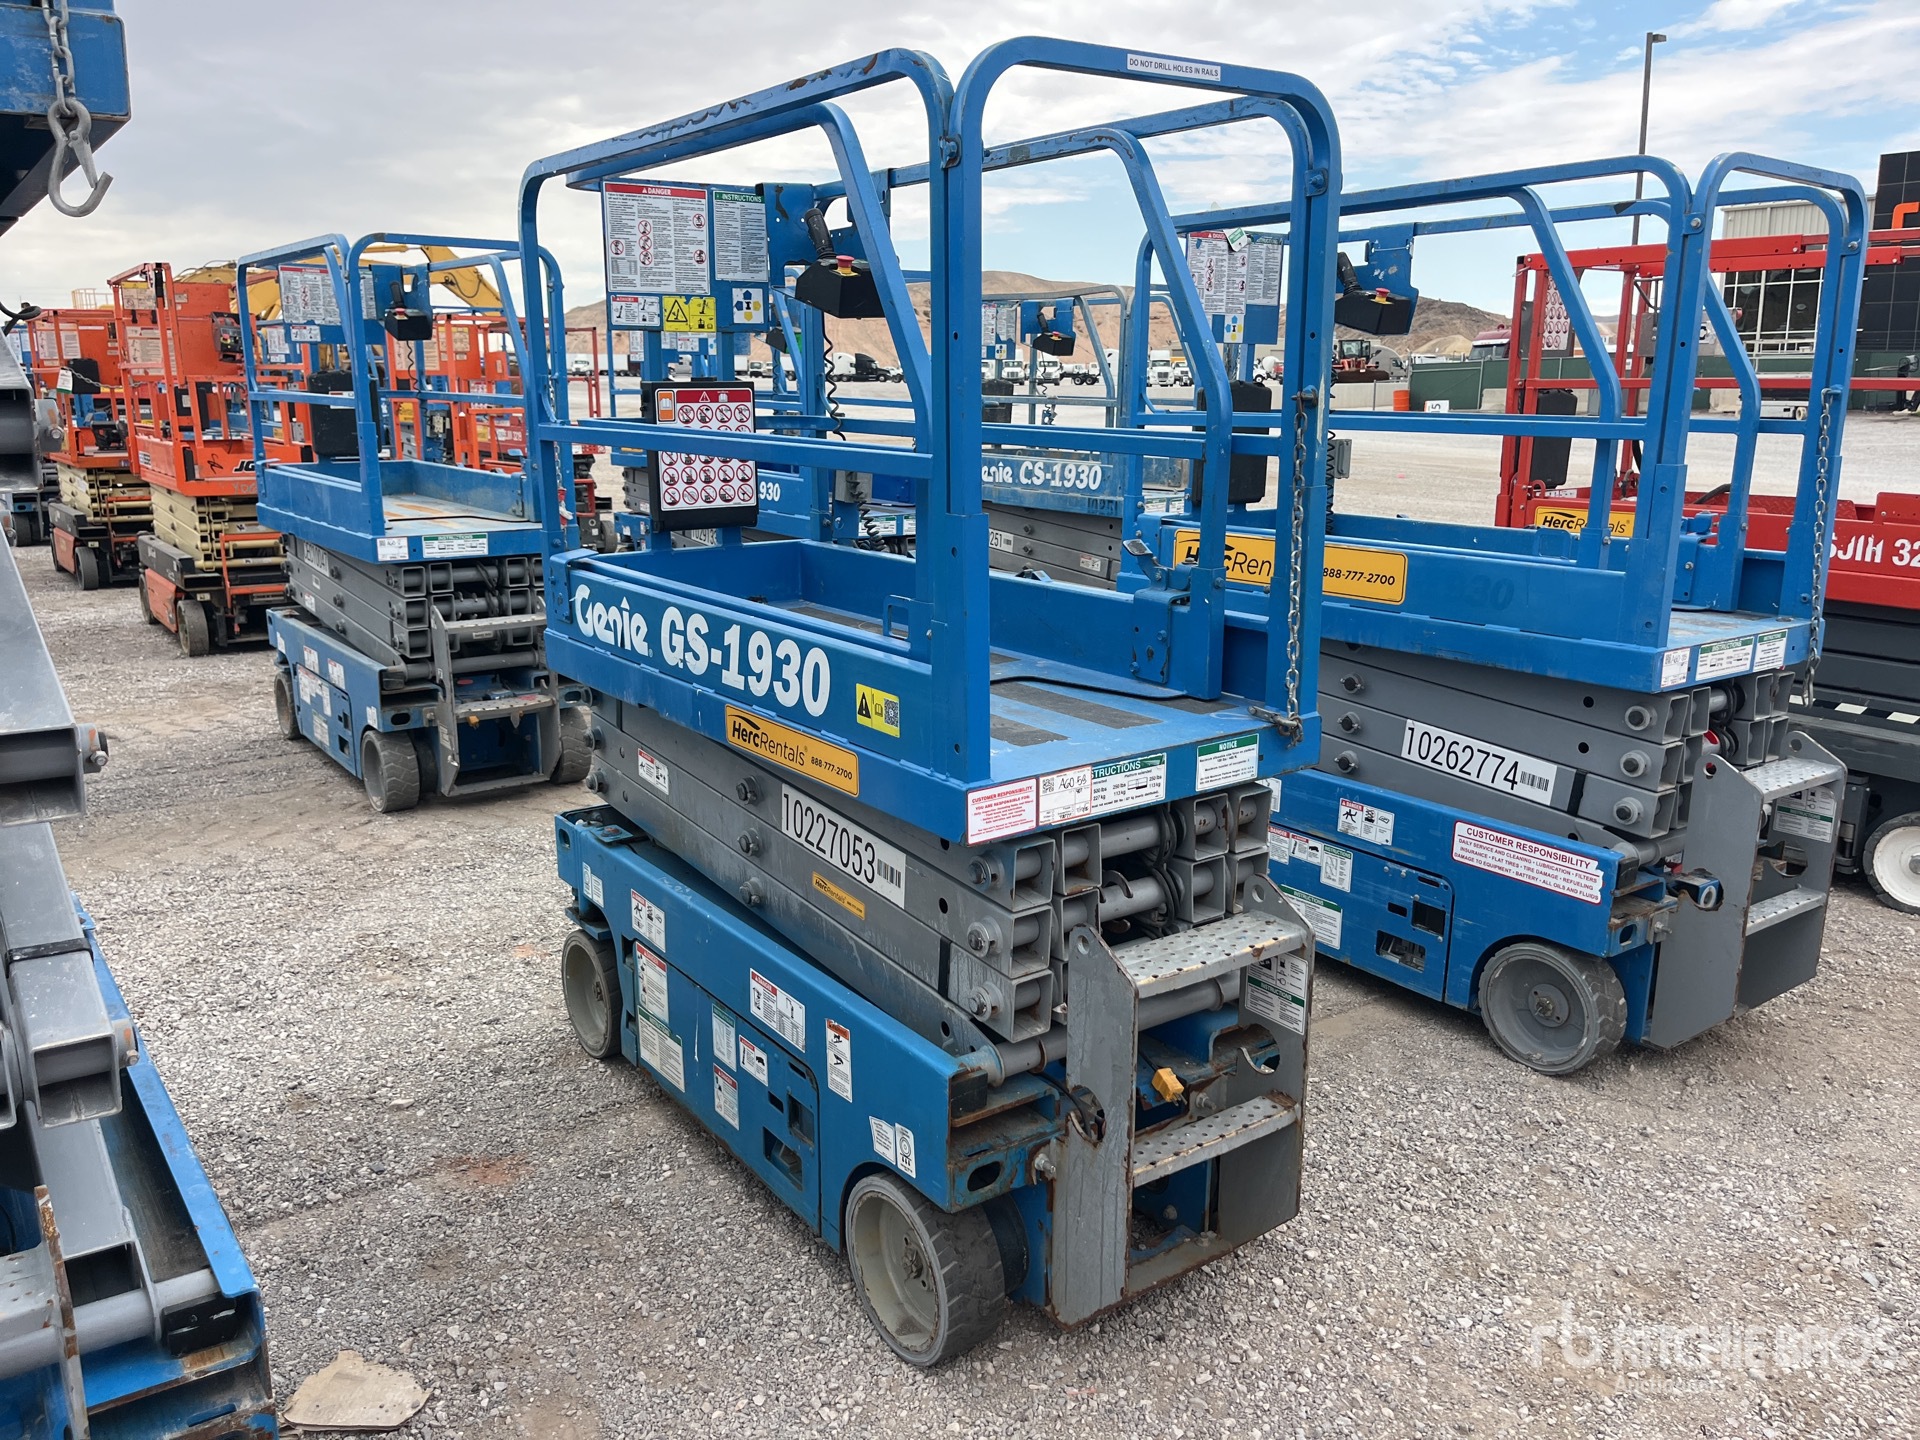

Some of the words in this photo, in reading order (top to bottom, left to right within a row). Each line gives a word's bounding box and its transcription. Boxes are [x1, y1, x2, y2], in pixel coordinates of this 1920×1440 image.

[1129, 58, 1139, 67] DO
[1140, 60, 1153, 68] NOT
[1154, 62, 1171, 71] DRILL
[1172, 64, 1192, 74] HOLES
[1194, 67, 1200, 75] IN
[1201, 68, 1219, 77] RAILS
[648, 187, 672, 196] DANGER
[721, 193, 762, 203] INSTRUCTIONS
[572, 584, 649, 657] Genie
[661, 606, 831, 718] GS-1930
[732, 720, 805, 767] HercRentals
[1219, 740, 1237, 751] NOTICE
[1407, 726, 1519, 791] 10262774
[972, 793, 997, 804] CUSTOMER
[997, 786, 1033, 798] RESPONSIBILITY
[783, 793, 875, 884] 10227053
[1459, 838, 1472, 846] DAILY
[1473, 842, 1493, 853] SERVICE
[1506, 852, 1531, 864] CLEANING
[1536, 861, 1571, 875] LUBRICATION
[1575, 872, 1597, 883] FILTERS
[1466, 827, 1514, 847] CUSTOMER
[1516, 841, 1591, 869] RESPONSIBILITY
[1454, 852, 1474, 863] DAMAGE
[1483, 861, 1511, 874] EQUIPMENT
[1516, 871, 1538, 882] BATTERY
[1542, 879, 1552, 887] ALL
[1553, 882, 1565, 891] OILS
[1566, 886, 1578, 894] AND
[1579, 889, 1599, 901] FLUIDS
[1460, 846, 1487, 859] INSURANCE
[1492, 855, 1503, 863] FLAT
[1505, 859, 1519, 868] TIRES
[1523, 865, 1534, 873] TIRE
[1536, 868, 1558, 880] DAMAGE
[1563, 877, 1593, 891] REFUELING
